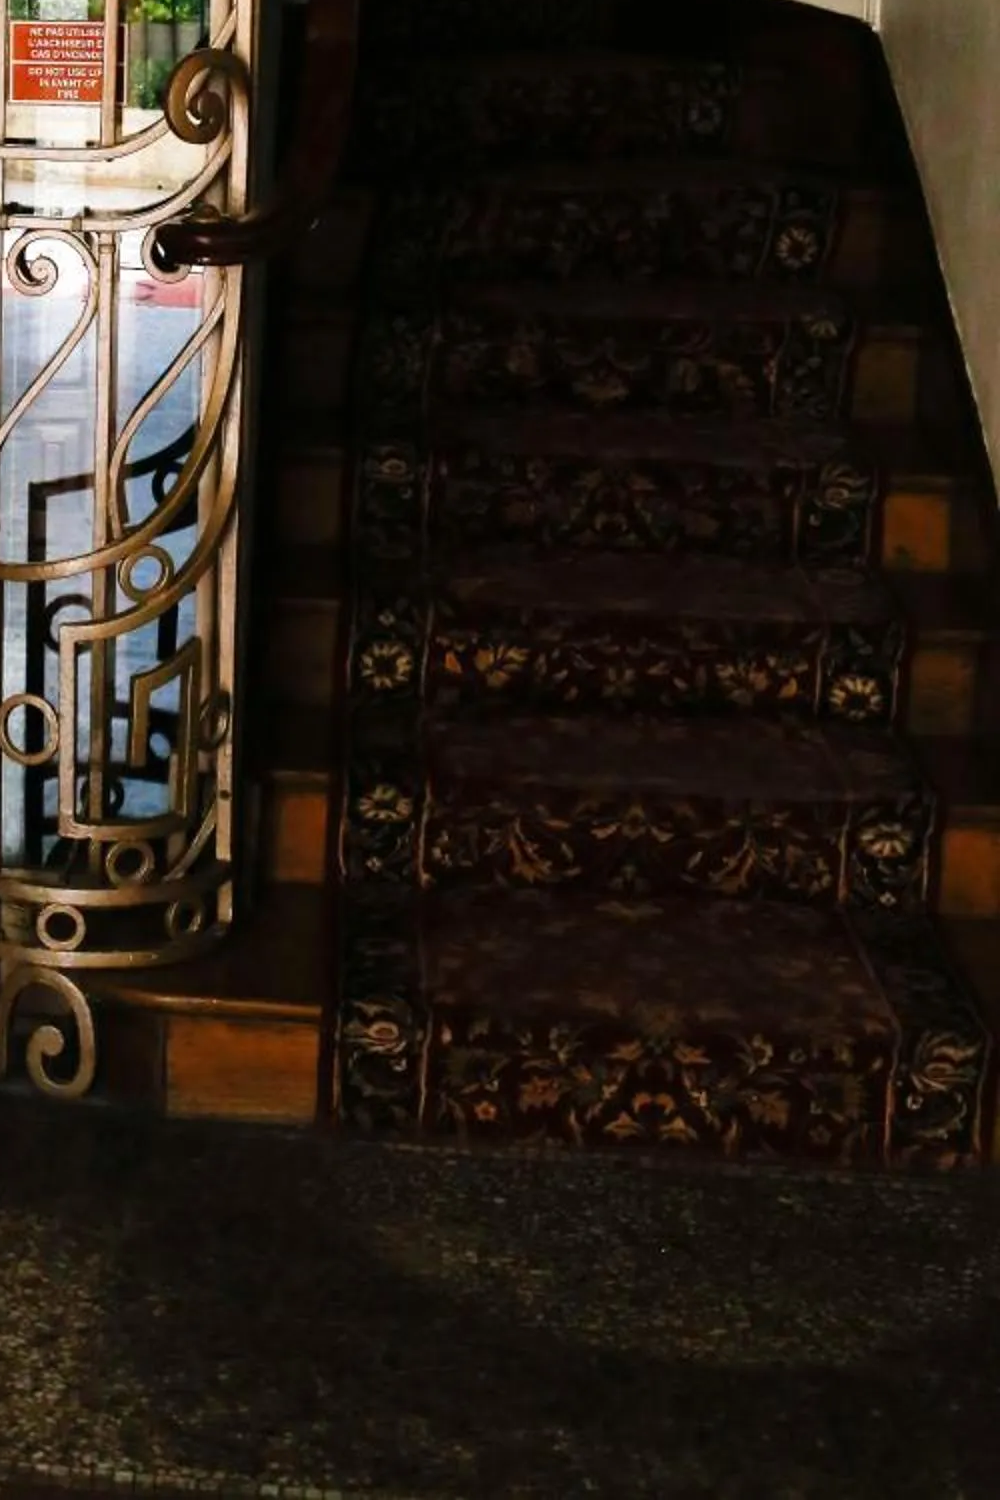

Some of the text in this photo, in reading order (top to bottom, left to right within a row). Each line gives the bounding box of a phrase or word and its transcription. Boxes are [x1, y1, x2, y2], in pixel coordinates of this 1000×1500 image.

[29, 27, 105, 37] NE PAS UTILISE
[31, 49, 50, 59] CAS
[28, 67, 103, 77] DO NOT USE LIF
[40, 78, 99, 88] IN EVENT OF
[57, 89, 79, 99] FIRE
